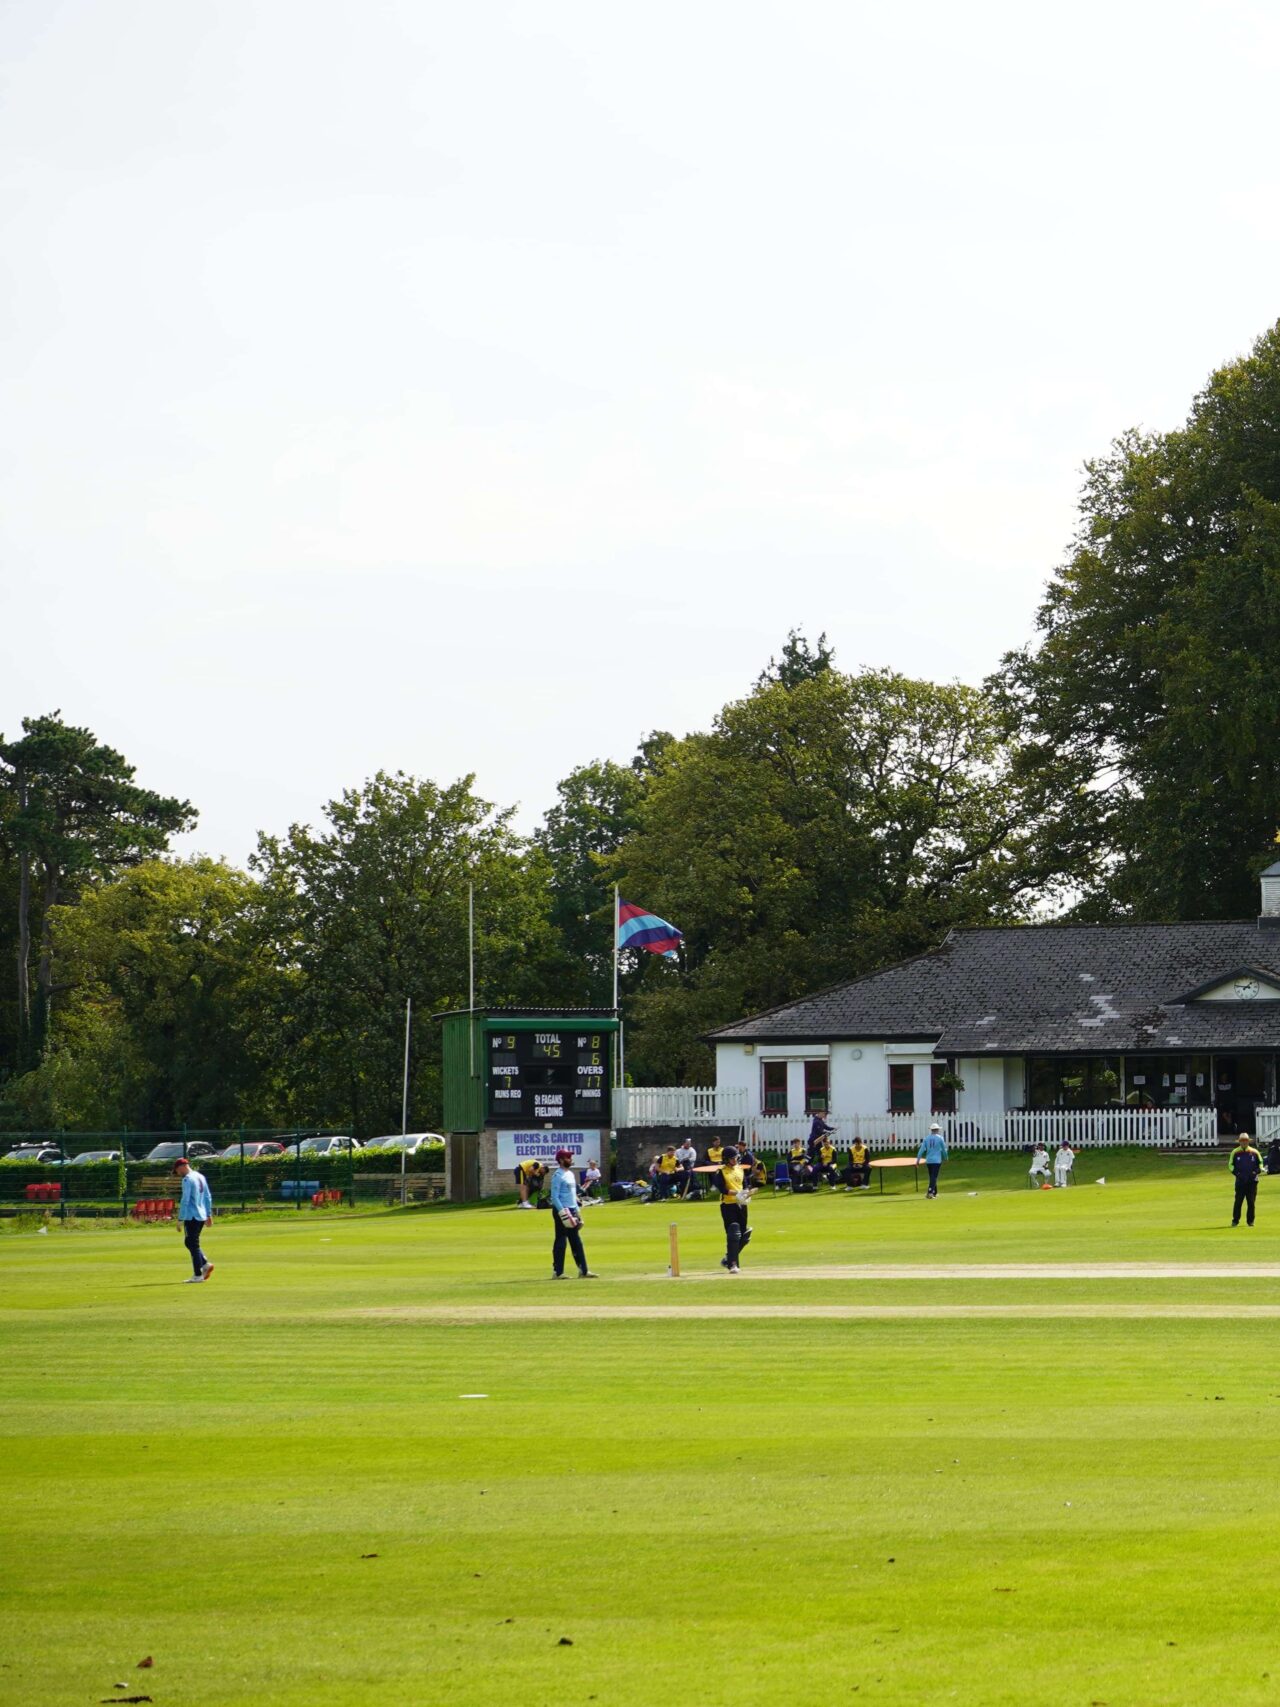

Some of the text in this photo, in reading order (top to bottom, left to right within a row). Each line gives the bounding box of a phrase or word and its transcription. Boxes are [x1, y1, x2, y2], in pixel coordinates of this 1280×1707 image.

[507, 1035, 515, 1049] 9
[534, 1033, 561, 1044] TOTAL
[591, 1035, 600, 1049] 8
[543, 1045, 561, 1058] 45
[591, 1052, 600, 1065] 6
[492, 1066, 519, 1075] WICKETS
[577, 1065, 604, 1075] OVERS
[504, 1076, 512, 1088] 7
[587, 1075, 601, 1088] 17
[494, 1089, 510, 1099] RUNS
[541, 1094, 563, 1105] FAGANS
[534, 1106, 564, 1117] FIELDING
[513, 1132, 584, 1144] HICKS & CARTER
